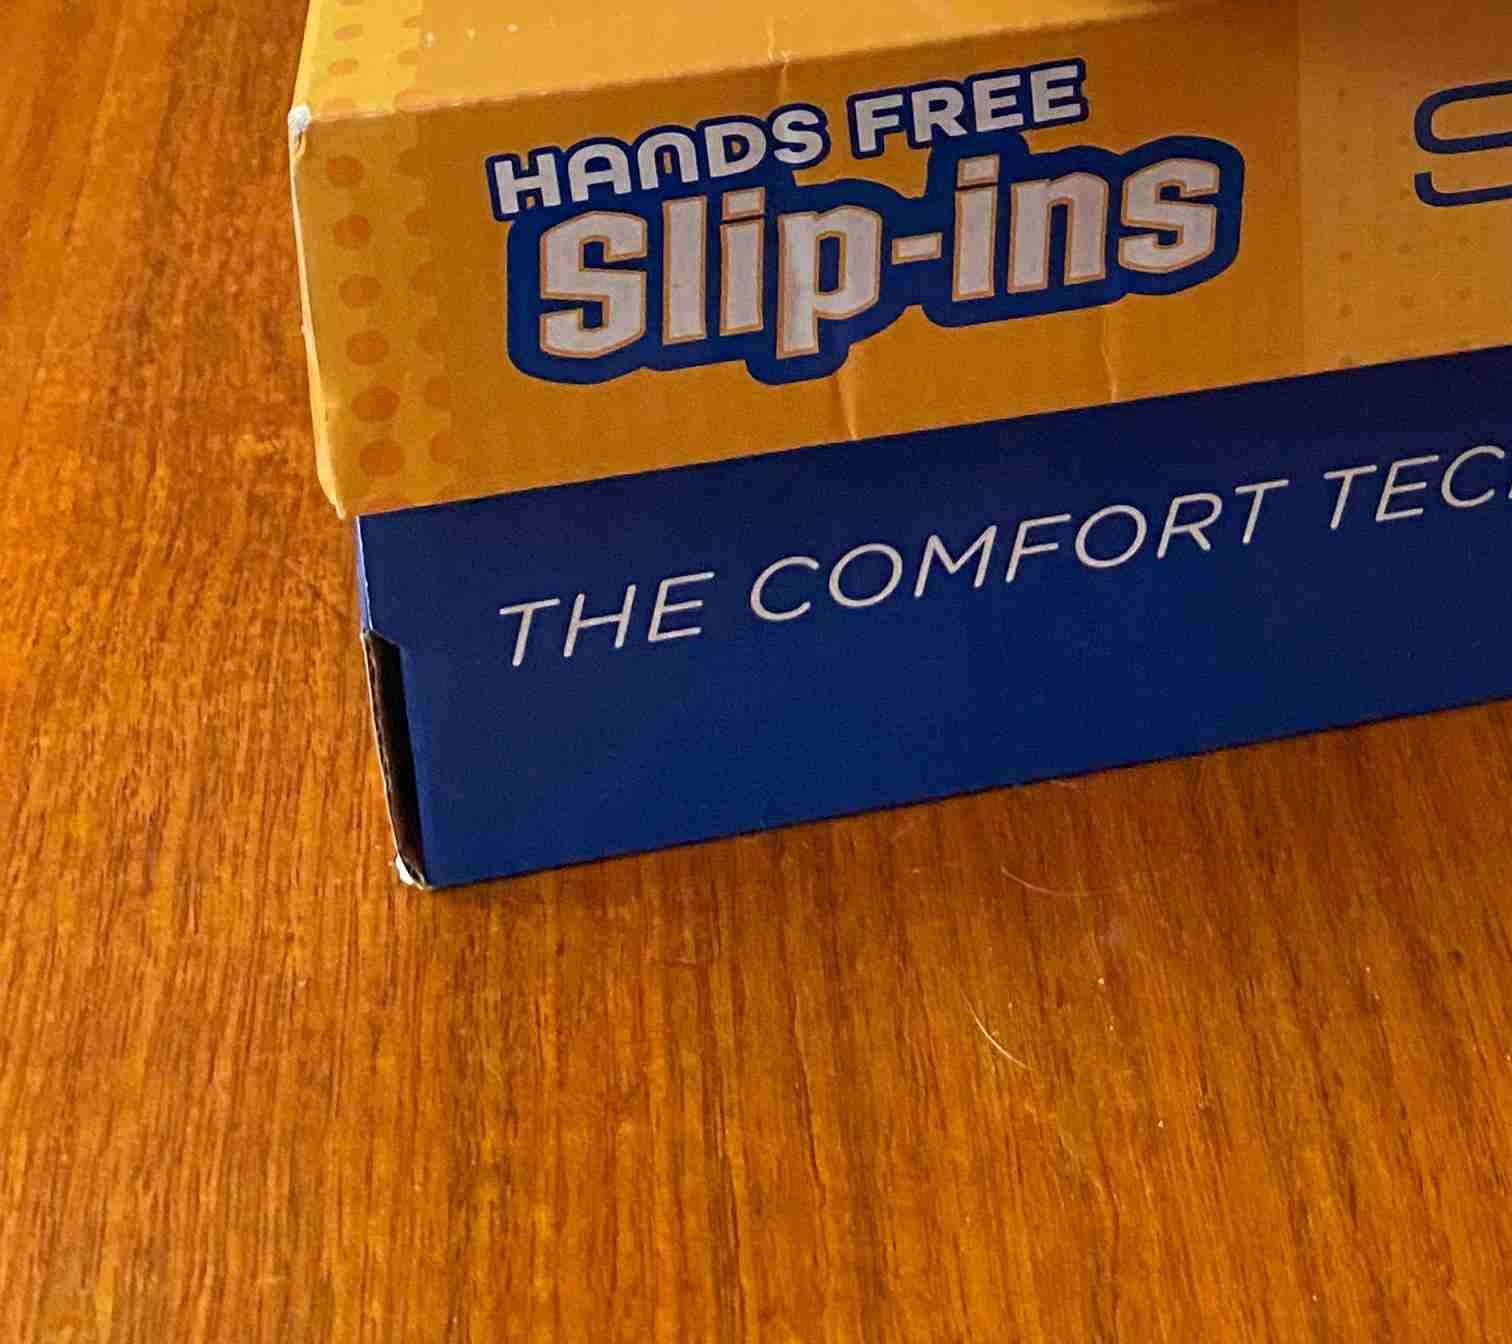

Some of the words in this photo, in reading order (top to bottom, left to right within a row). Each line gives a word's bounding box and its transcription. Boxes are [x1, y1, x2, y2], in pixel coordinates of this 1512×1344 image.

[493, 108, 825, 215] HANDS
[854, 64, 1082, 154] FREE
[539, 153, 1222, 360] Slip-ins
[499, 570, 715, 668] THE
[749, 478, 1290, 623] COMFORT
